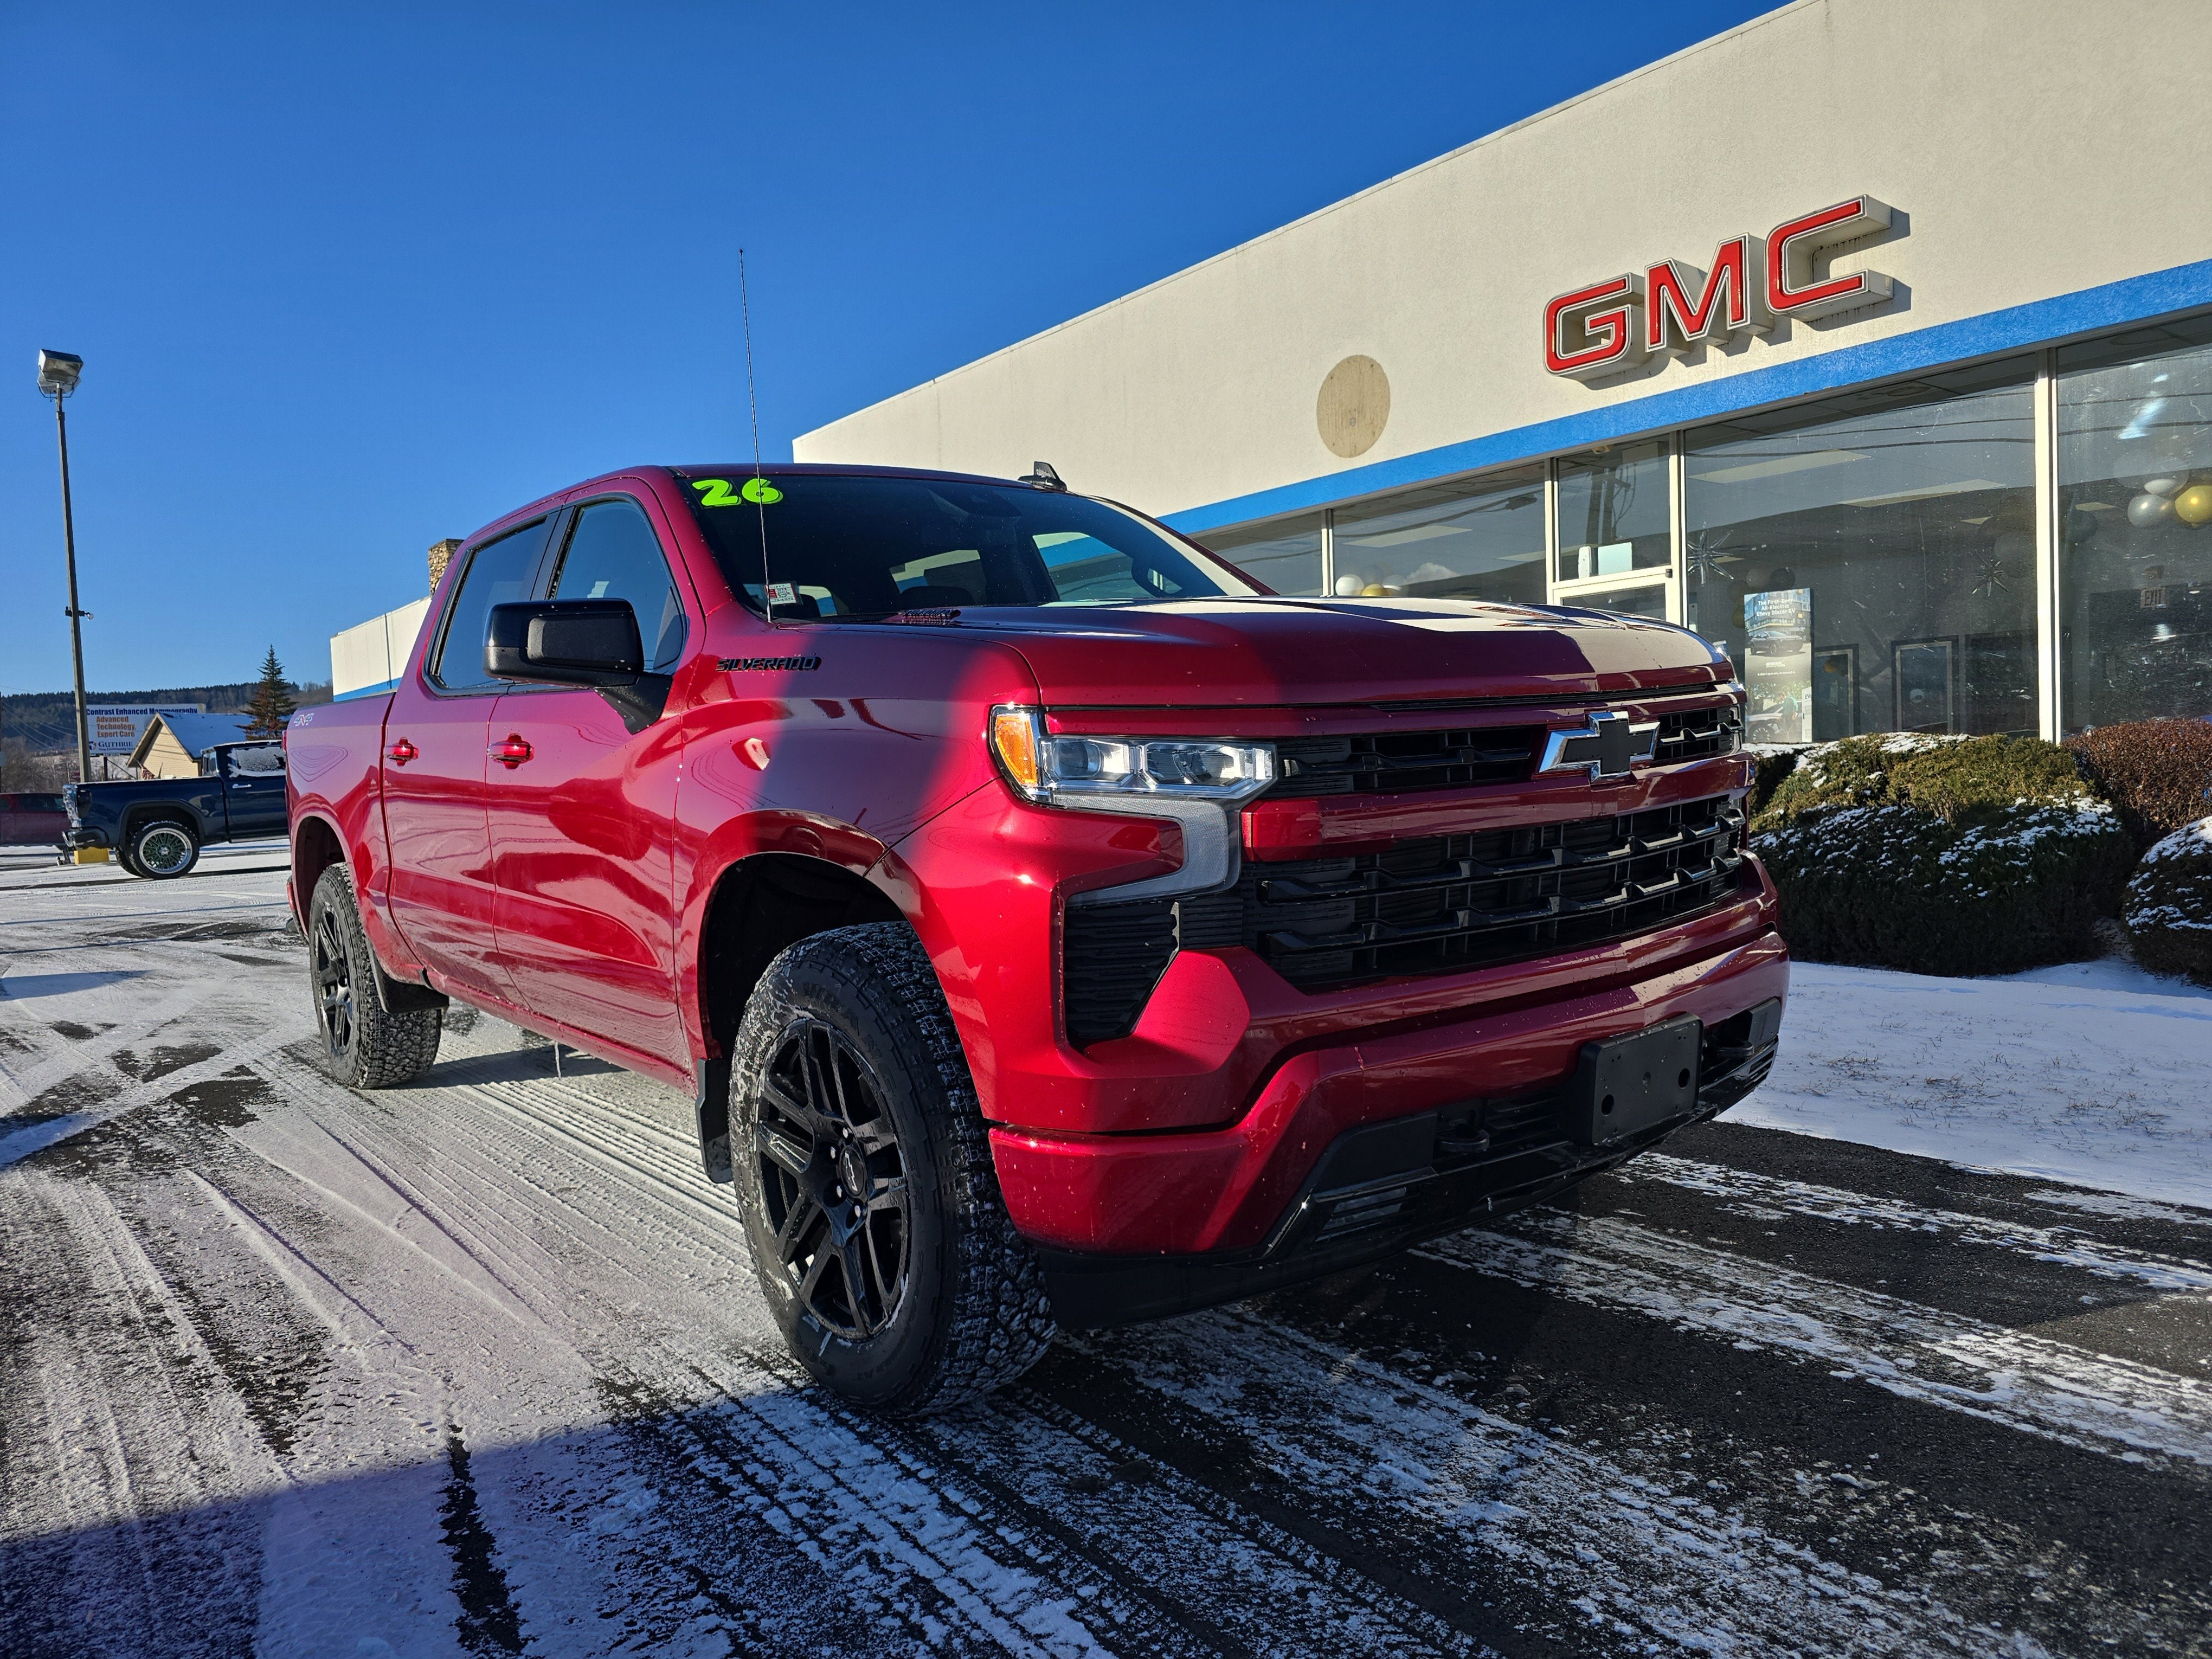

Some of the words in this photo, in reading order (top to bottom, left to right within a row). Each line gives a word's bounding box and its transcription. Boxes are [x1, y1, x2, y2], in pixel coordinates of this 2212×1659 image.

[1542, 194, 1870, 377] GMC
[692, 479, 783, 507] 26
[2144, 589, 2163, 606] EXIT
[716, 656, 821, 672] SILVERADO
